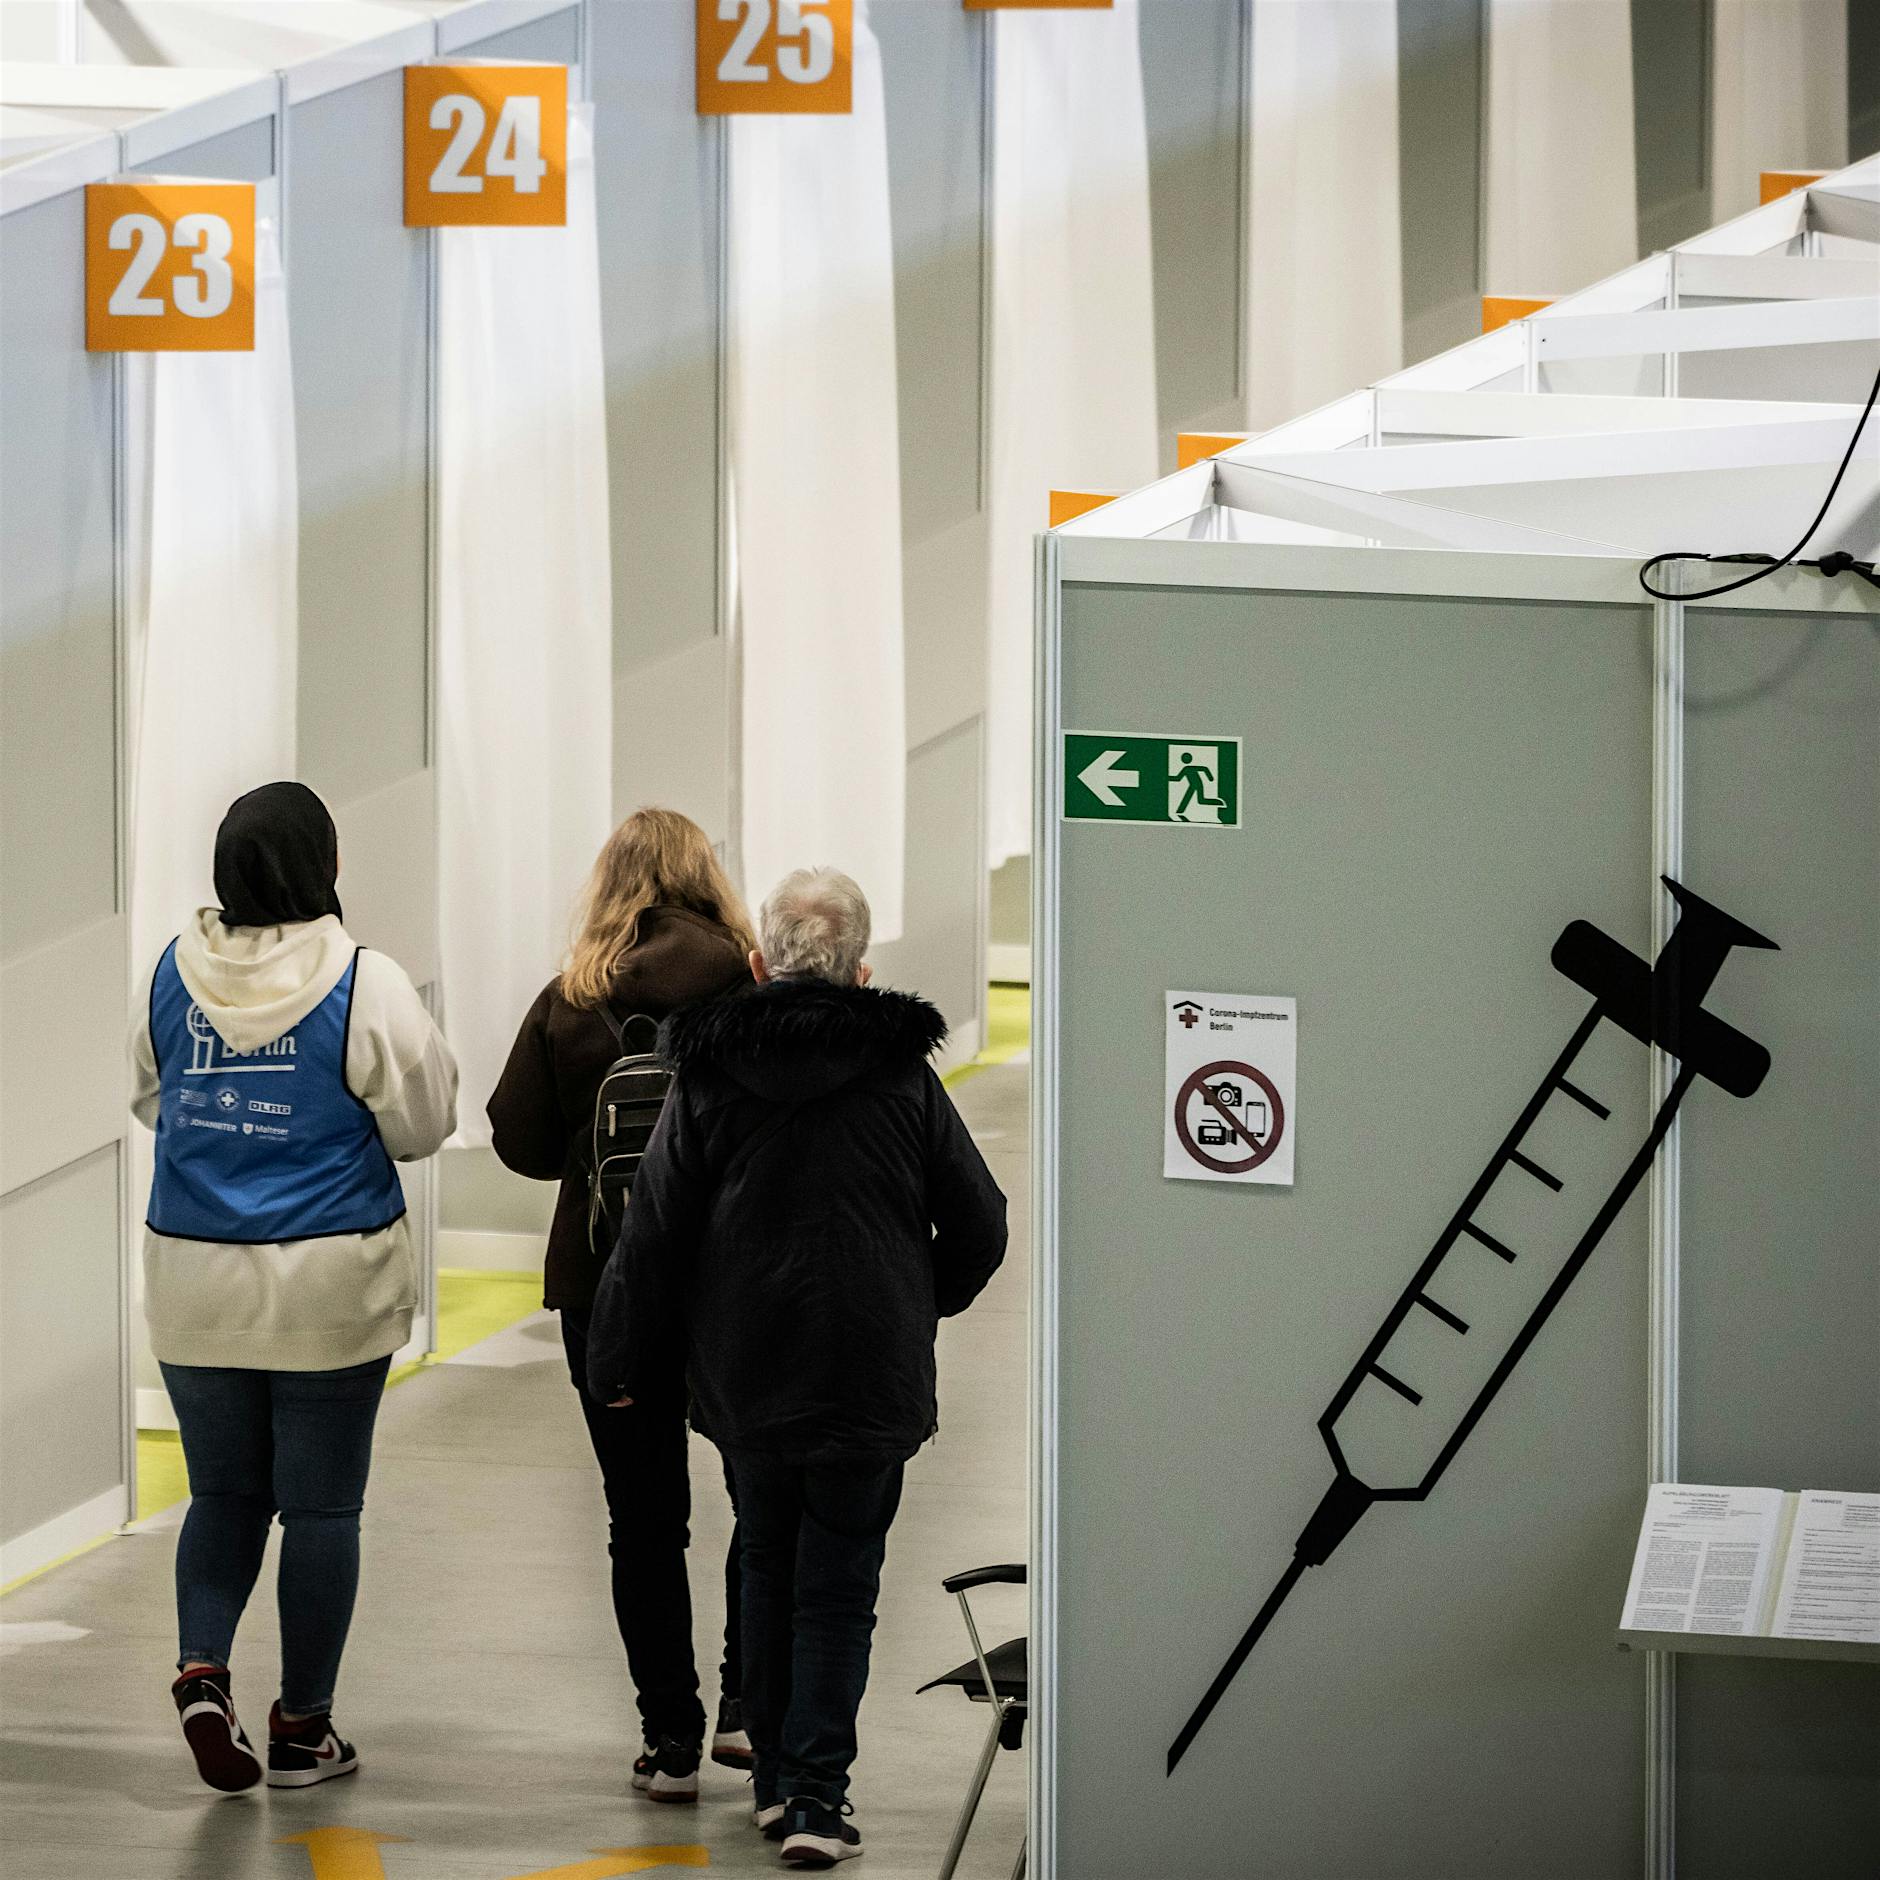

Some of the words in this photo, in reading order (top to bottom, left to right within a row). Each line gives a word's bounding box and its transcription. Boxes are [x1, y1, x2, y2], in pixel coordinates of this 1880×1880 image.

[717, 0, 833, 82] 25
[429, 95, 546, 194] 24
[108, 213, 233, 318] 23
[1209, 1021, 1234, 1031] Berlin
[251, 1102, 289, 1114] DLRG
[255, 1125, 288, 1135] Malteser
